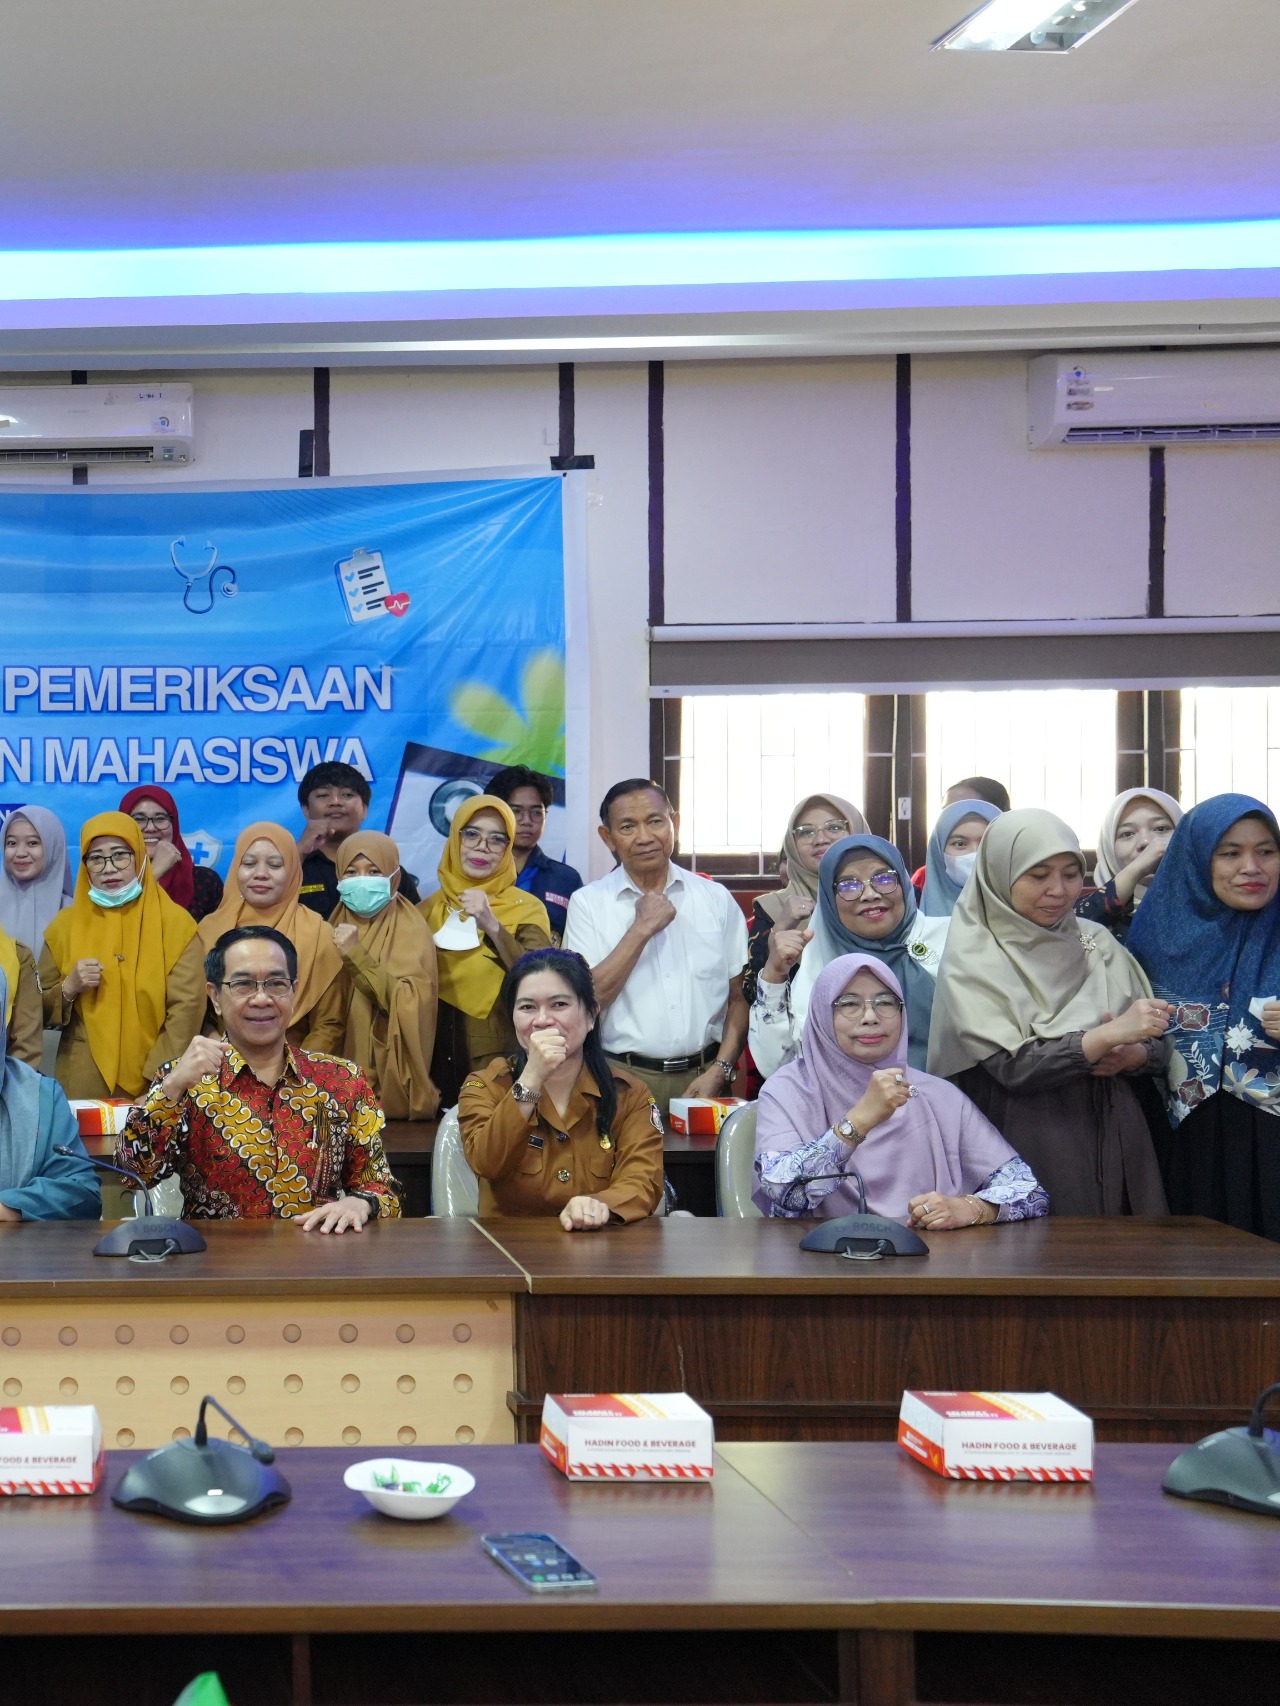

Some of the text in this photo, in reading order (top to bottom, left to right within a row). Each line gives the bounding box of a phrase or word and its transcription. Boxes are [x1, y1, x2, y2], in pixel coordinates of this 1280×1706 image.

[4, 664, 392, 712] PEMERIKSAAN
[44, 736, 374, 783] MAHASISWA
[143, 1223, 177, 1233] BOSCH
[852, 1222, 892, 1233] BOSCH
[584, 1439, 614, 1447] HADIN
[650, 1440, 697, 1448] BEVERAGE
[994, 1442, 1020, 1450] FOOD
[1022, 1442, 1028, 1450] &
[1030, 1442, 1077, 1451] BEVERAGE
